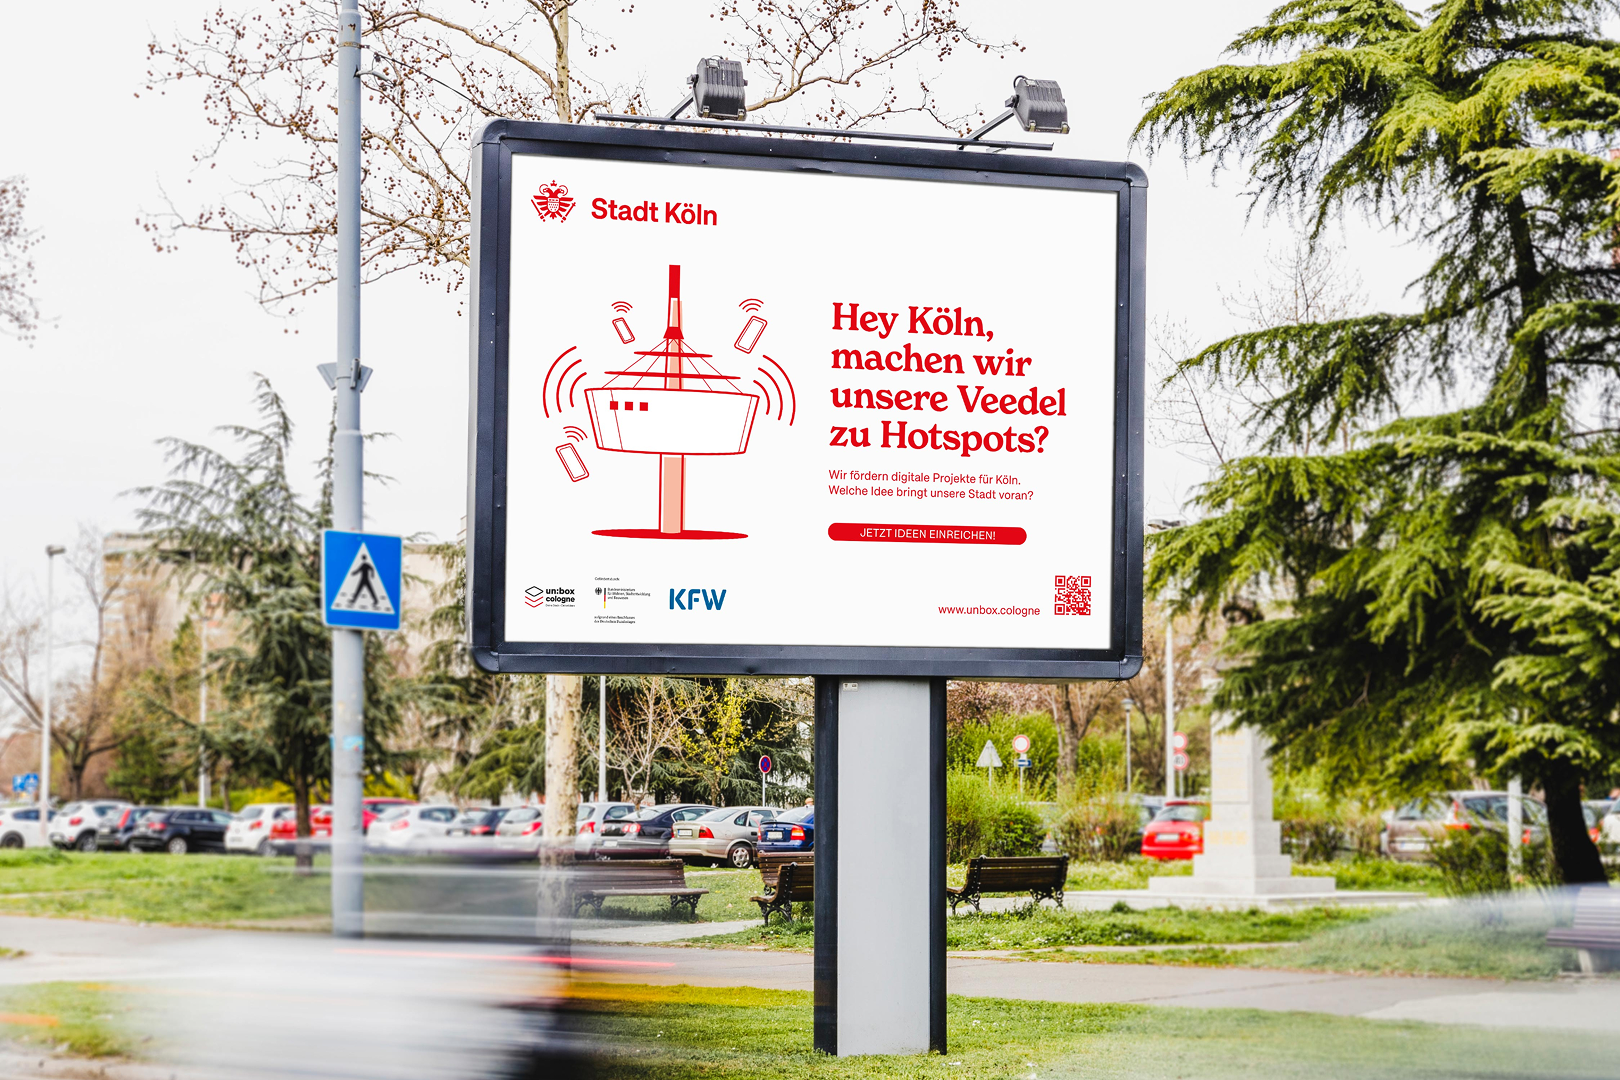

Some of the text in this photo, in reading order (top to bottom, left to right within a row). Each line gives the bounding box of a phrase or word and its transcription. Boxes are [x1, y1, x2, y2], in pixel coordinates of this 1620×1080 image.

[591, 198, 718, 226] Stadt Köln
[832, 302, 994, 342] Hey Köln,
[831, 343, 1032, 376] machen wir
[830, 385, 1067, 416] unsere Veedel
[829, 421, 1049, 457] zu Hotspots?
[829, 469, 1021, 486] Wir fördern digitale Projekte für Köln.
[828, 484, 1034, 501] Welche Idee bringt unsere Stadt voran?
[860, 528, 996, 540] JETZT IDEEN EINREICHEN!
[545, 595, 576, 604] cologne
[546, 587, 575, 595] un:box
[669, 588, 727, 611] KFW
[937, 604, 1041, 618] www.unbox.cologne
